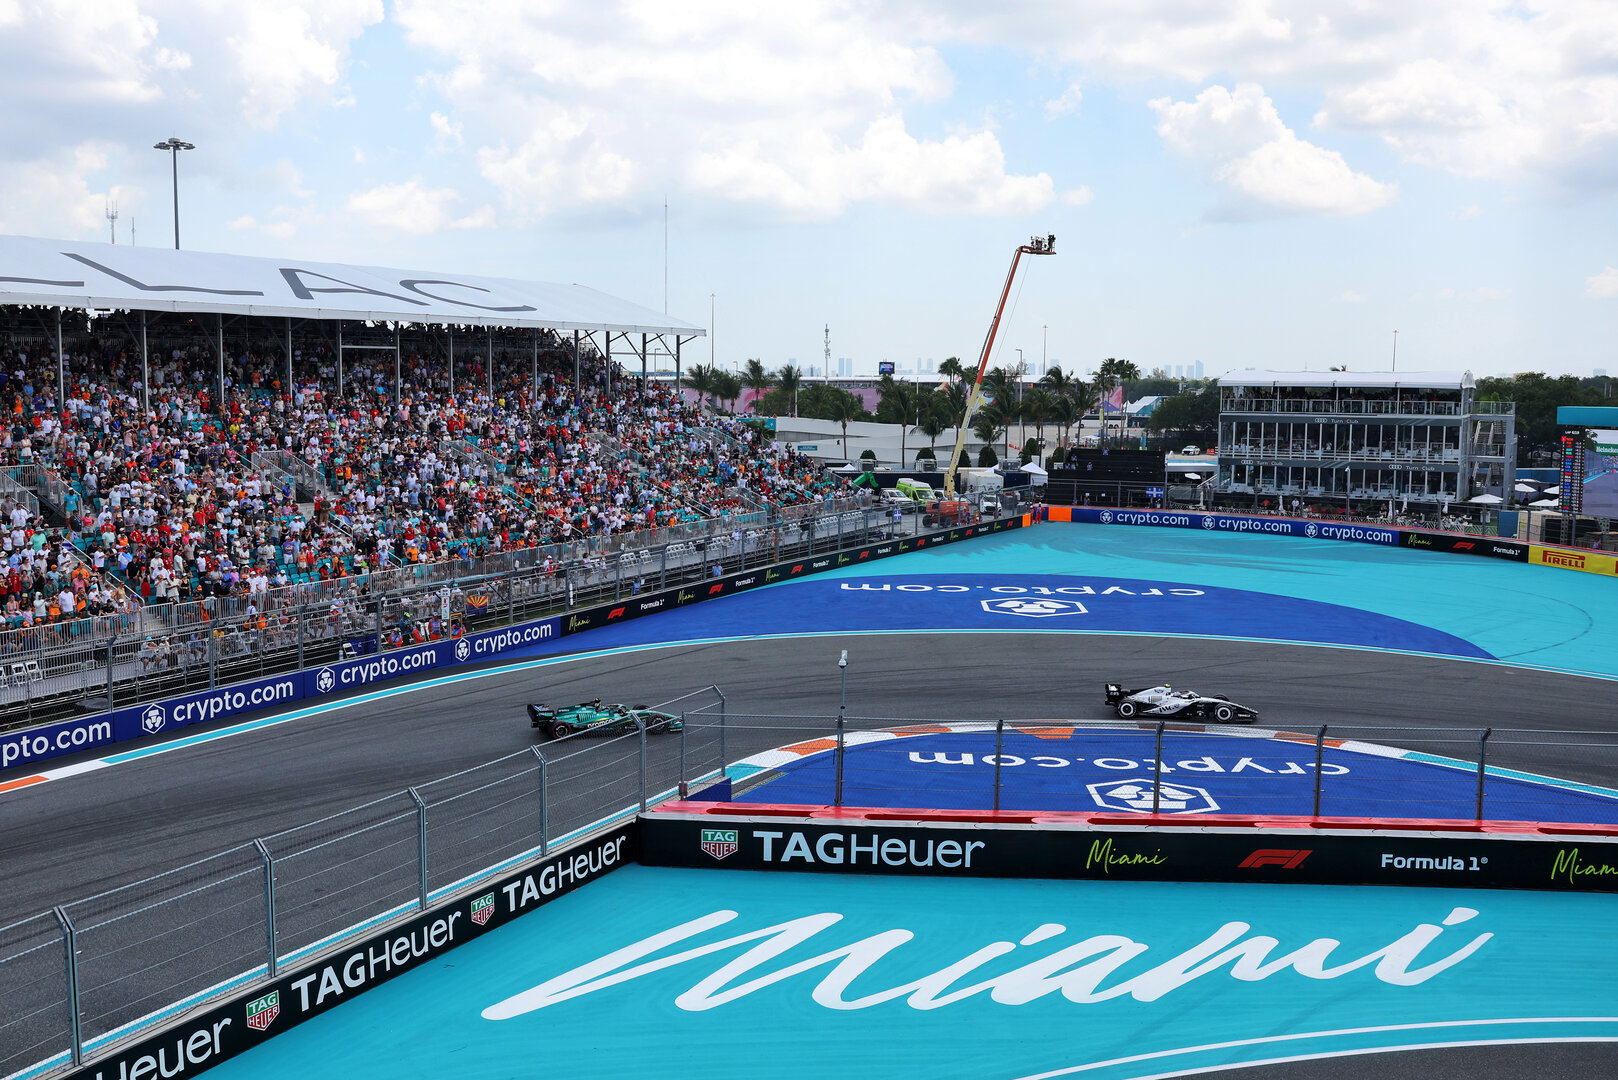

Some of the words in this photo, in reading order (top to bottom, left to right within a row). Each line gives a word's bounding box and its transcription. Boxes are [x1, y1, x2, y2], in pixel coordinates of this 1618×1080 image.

[1117, 512, 1189, 526] crypto.com
[1219, 518, 1291, 533] crypto.com
[1322, 525, 1392, 543] crypto.com
[1493, 546, 1515, 555] Formula
[1542, 550, 1586, 569] PIRELLI
[841, 583, 1206, 597] crypto.com
[640, 601, 660, 610] Formula
[474, 623, 552, 653] crypto.com
[341, 648, 437, 684] crypto.com
[173, 680, 293, 720] crypto.com
[0, 720, 111, 767] pto.com
[908, 751, 1350, 775] crypto.com
[704, 831, 735, 842] TAG
[703, 842, 736, 858] HEUER
[1086, 838, 1168, 874] Miami
[1381, 853, 1464, 871] Formula
[472, 895, 493, 911] TAG
[472, 905, 494, 923] HEUER
[481, 906, 1494, 1021] Miami
[249, 994, 277, 1014] TAG
[249, 1007, 278, 1028] HEUER
